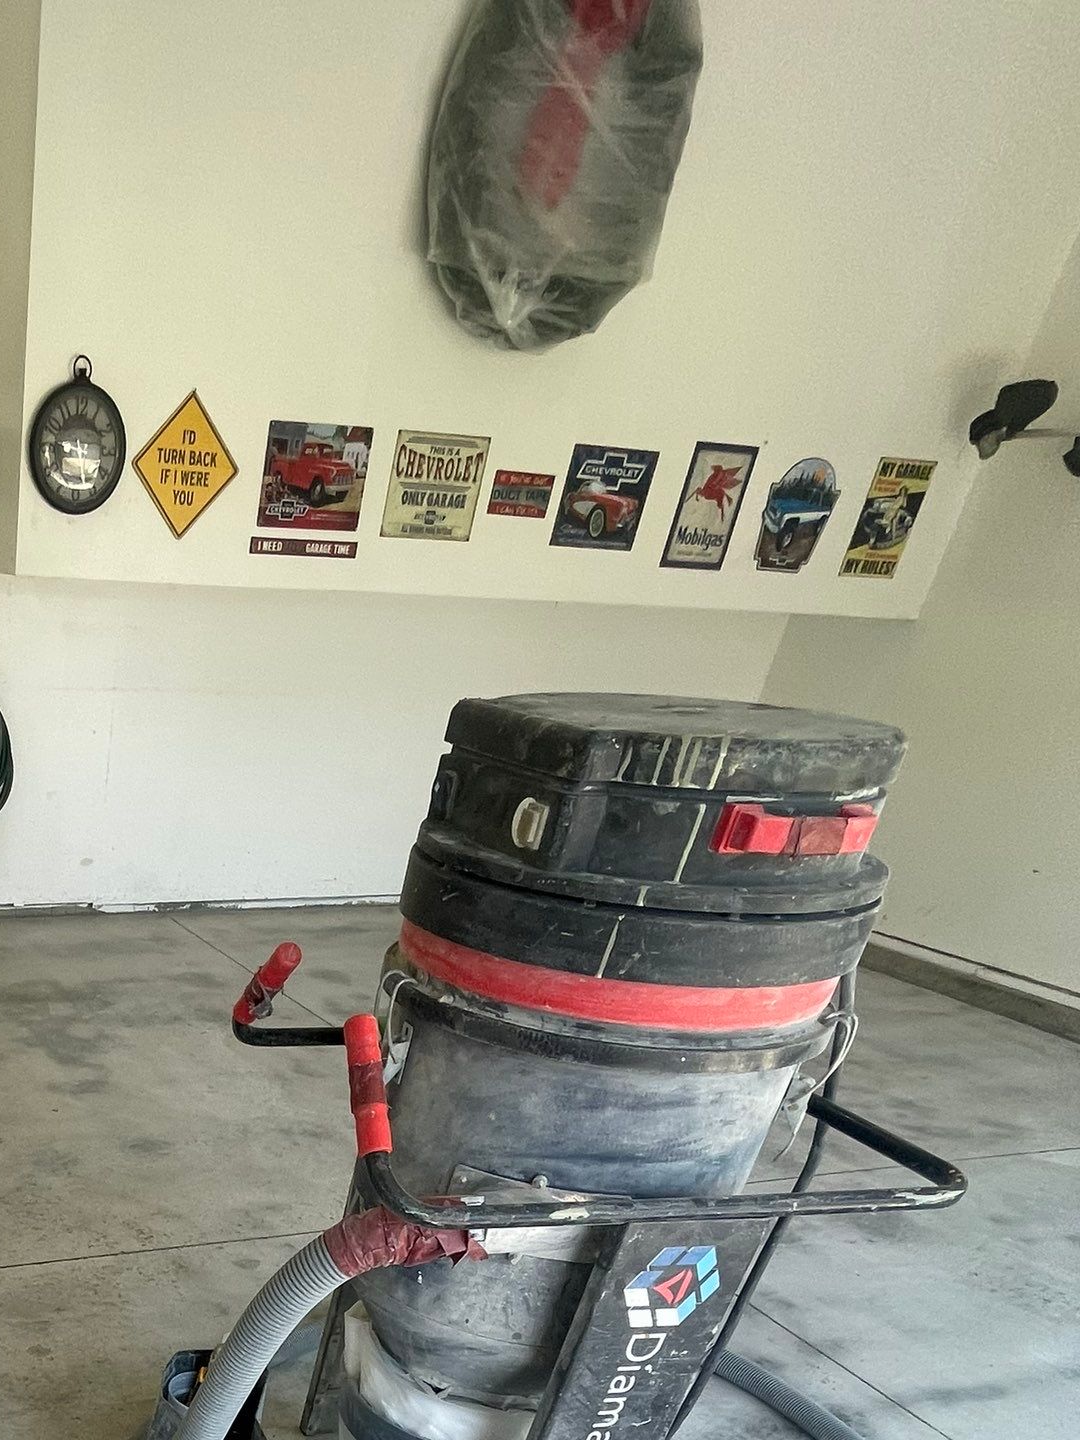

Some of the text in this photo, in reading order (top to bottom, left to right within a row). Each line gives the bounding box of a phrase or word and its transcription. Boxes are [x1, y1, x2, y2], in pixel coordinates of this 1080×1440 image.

[182, 429, 196, 445] I'D
[157, 447, 218, 468] TURN BACK
[430, 446, 462, 456] THIS IS A
[396, 443, 485, 483] CHEVROLET
[584, 464, 640, 478] CHEVROLET
[879, 462, 897, 477] MY
[160, 468, 211, 488] IF I WERE
[173, 489, 195, 507] YOU
[401, 490, 467, 509] ONLY GARAGE
[493, 489, 521, 501] DUCT
[675, 525, 724, 551] Mobilgas
[257, 541, 350, 555] I NEED GARAGE TIME
[843, 559, 861, 573] MY
